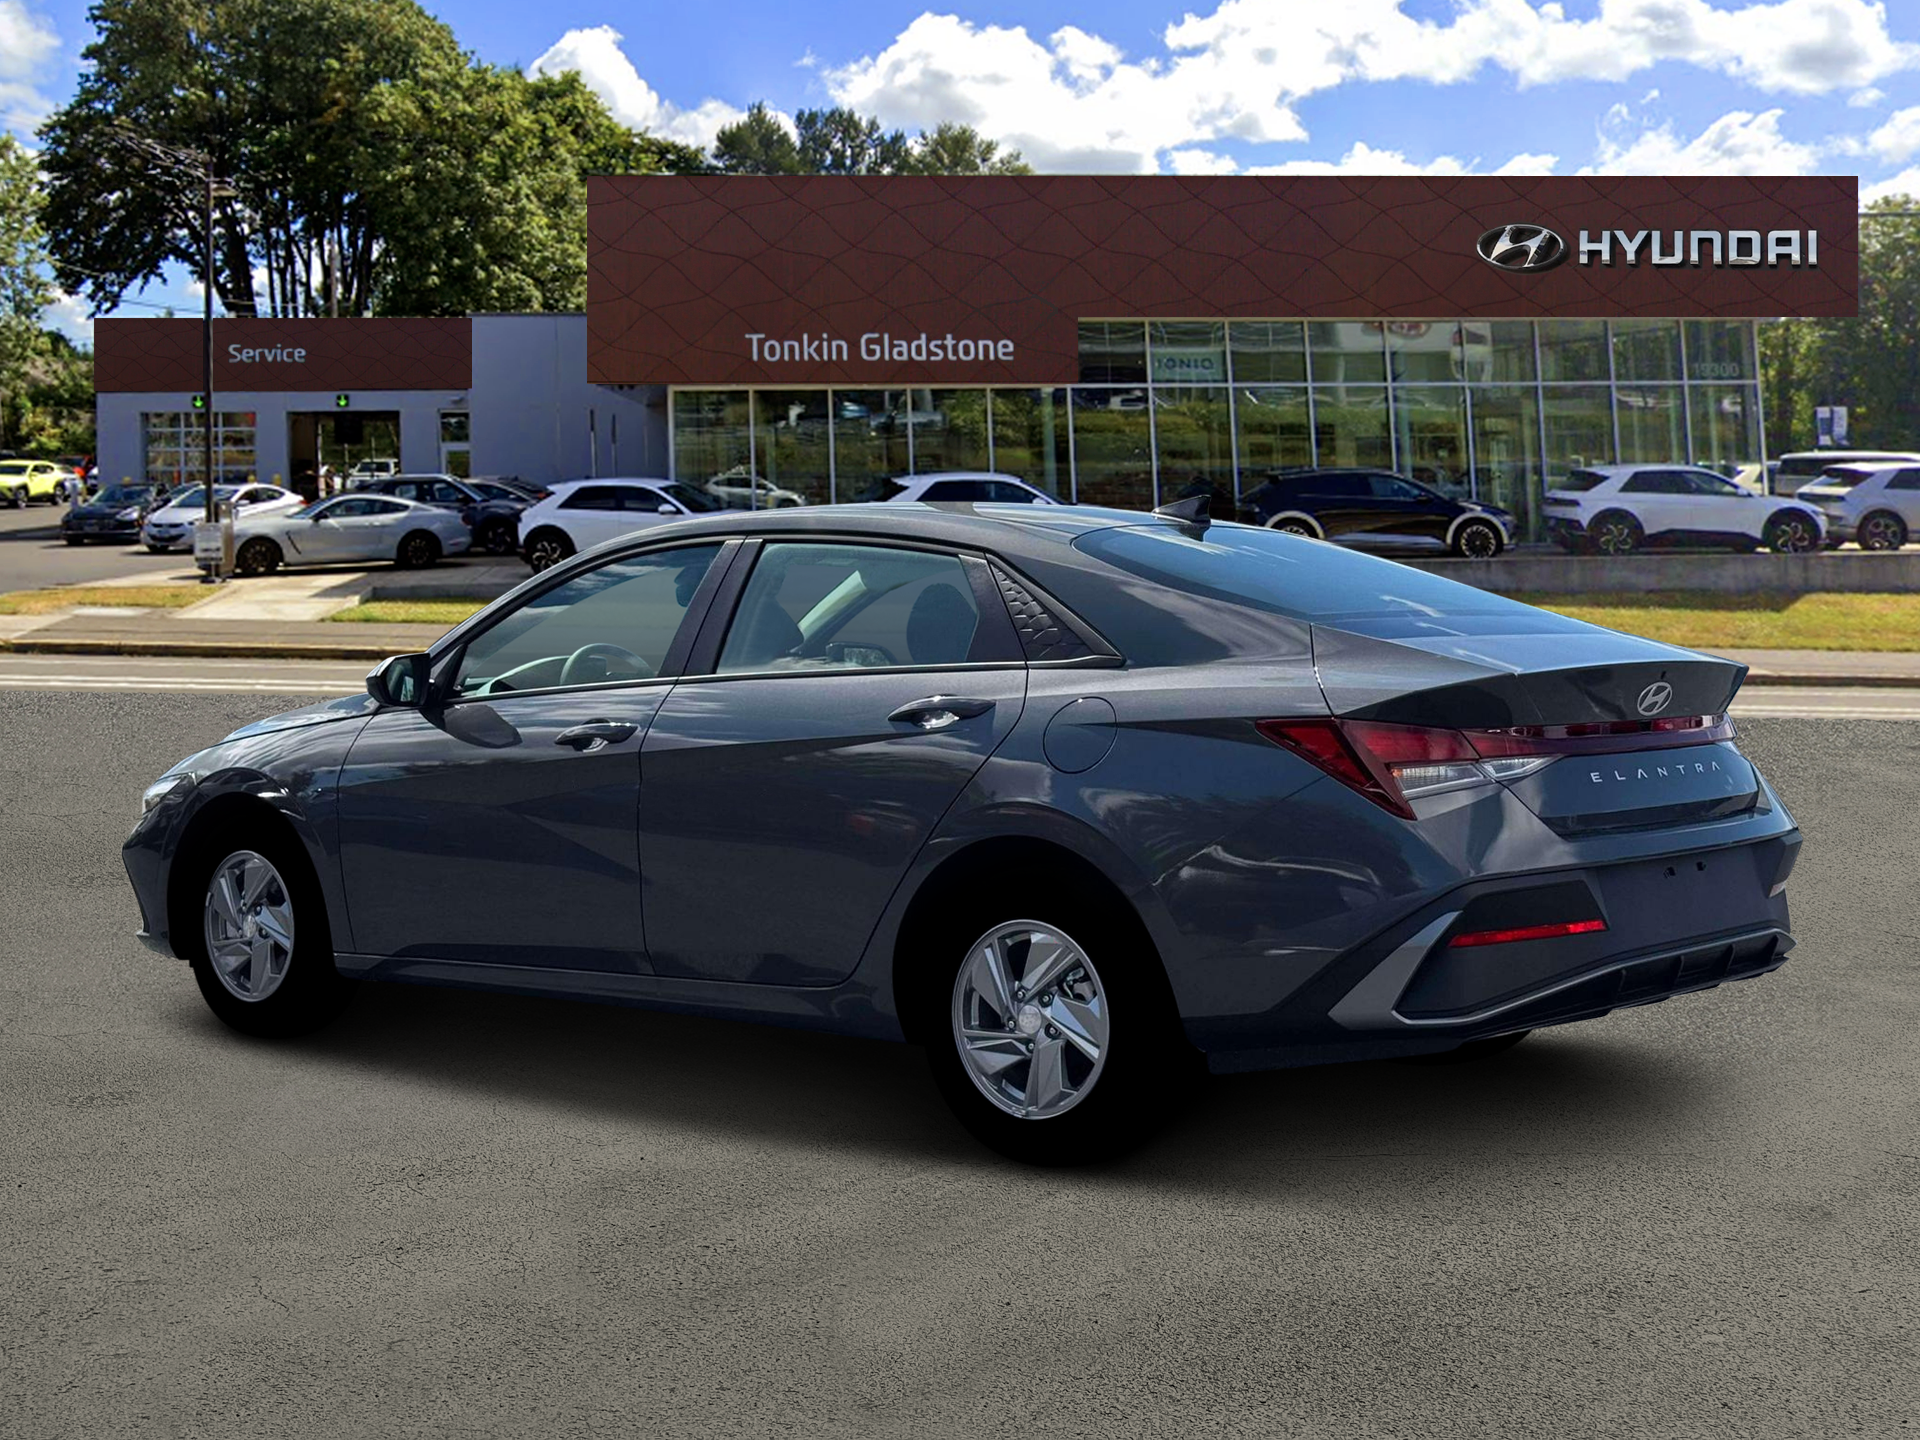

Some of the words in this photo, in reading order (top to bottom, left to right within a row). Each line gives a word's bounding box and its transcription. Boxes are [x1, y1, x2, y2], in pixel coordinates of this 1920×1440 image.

[1579, 230, 1817, 265] HYUNDAI
[228, 343, 307, 363] Service
[745, 333, 848, 362] Tonkin
[860, 333, 1015, 362] Gladstone
[1590, 761, 1720, 783] ELANTRA
